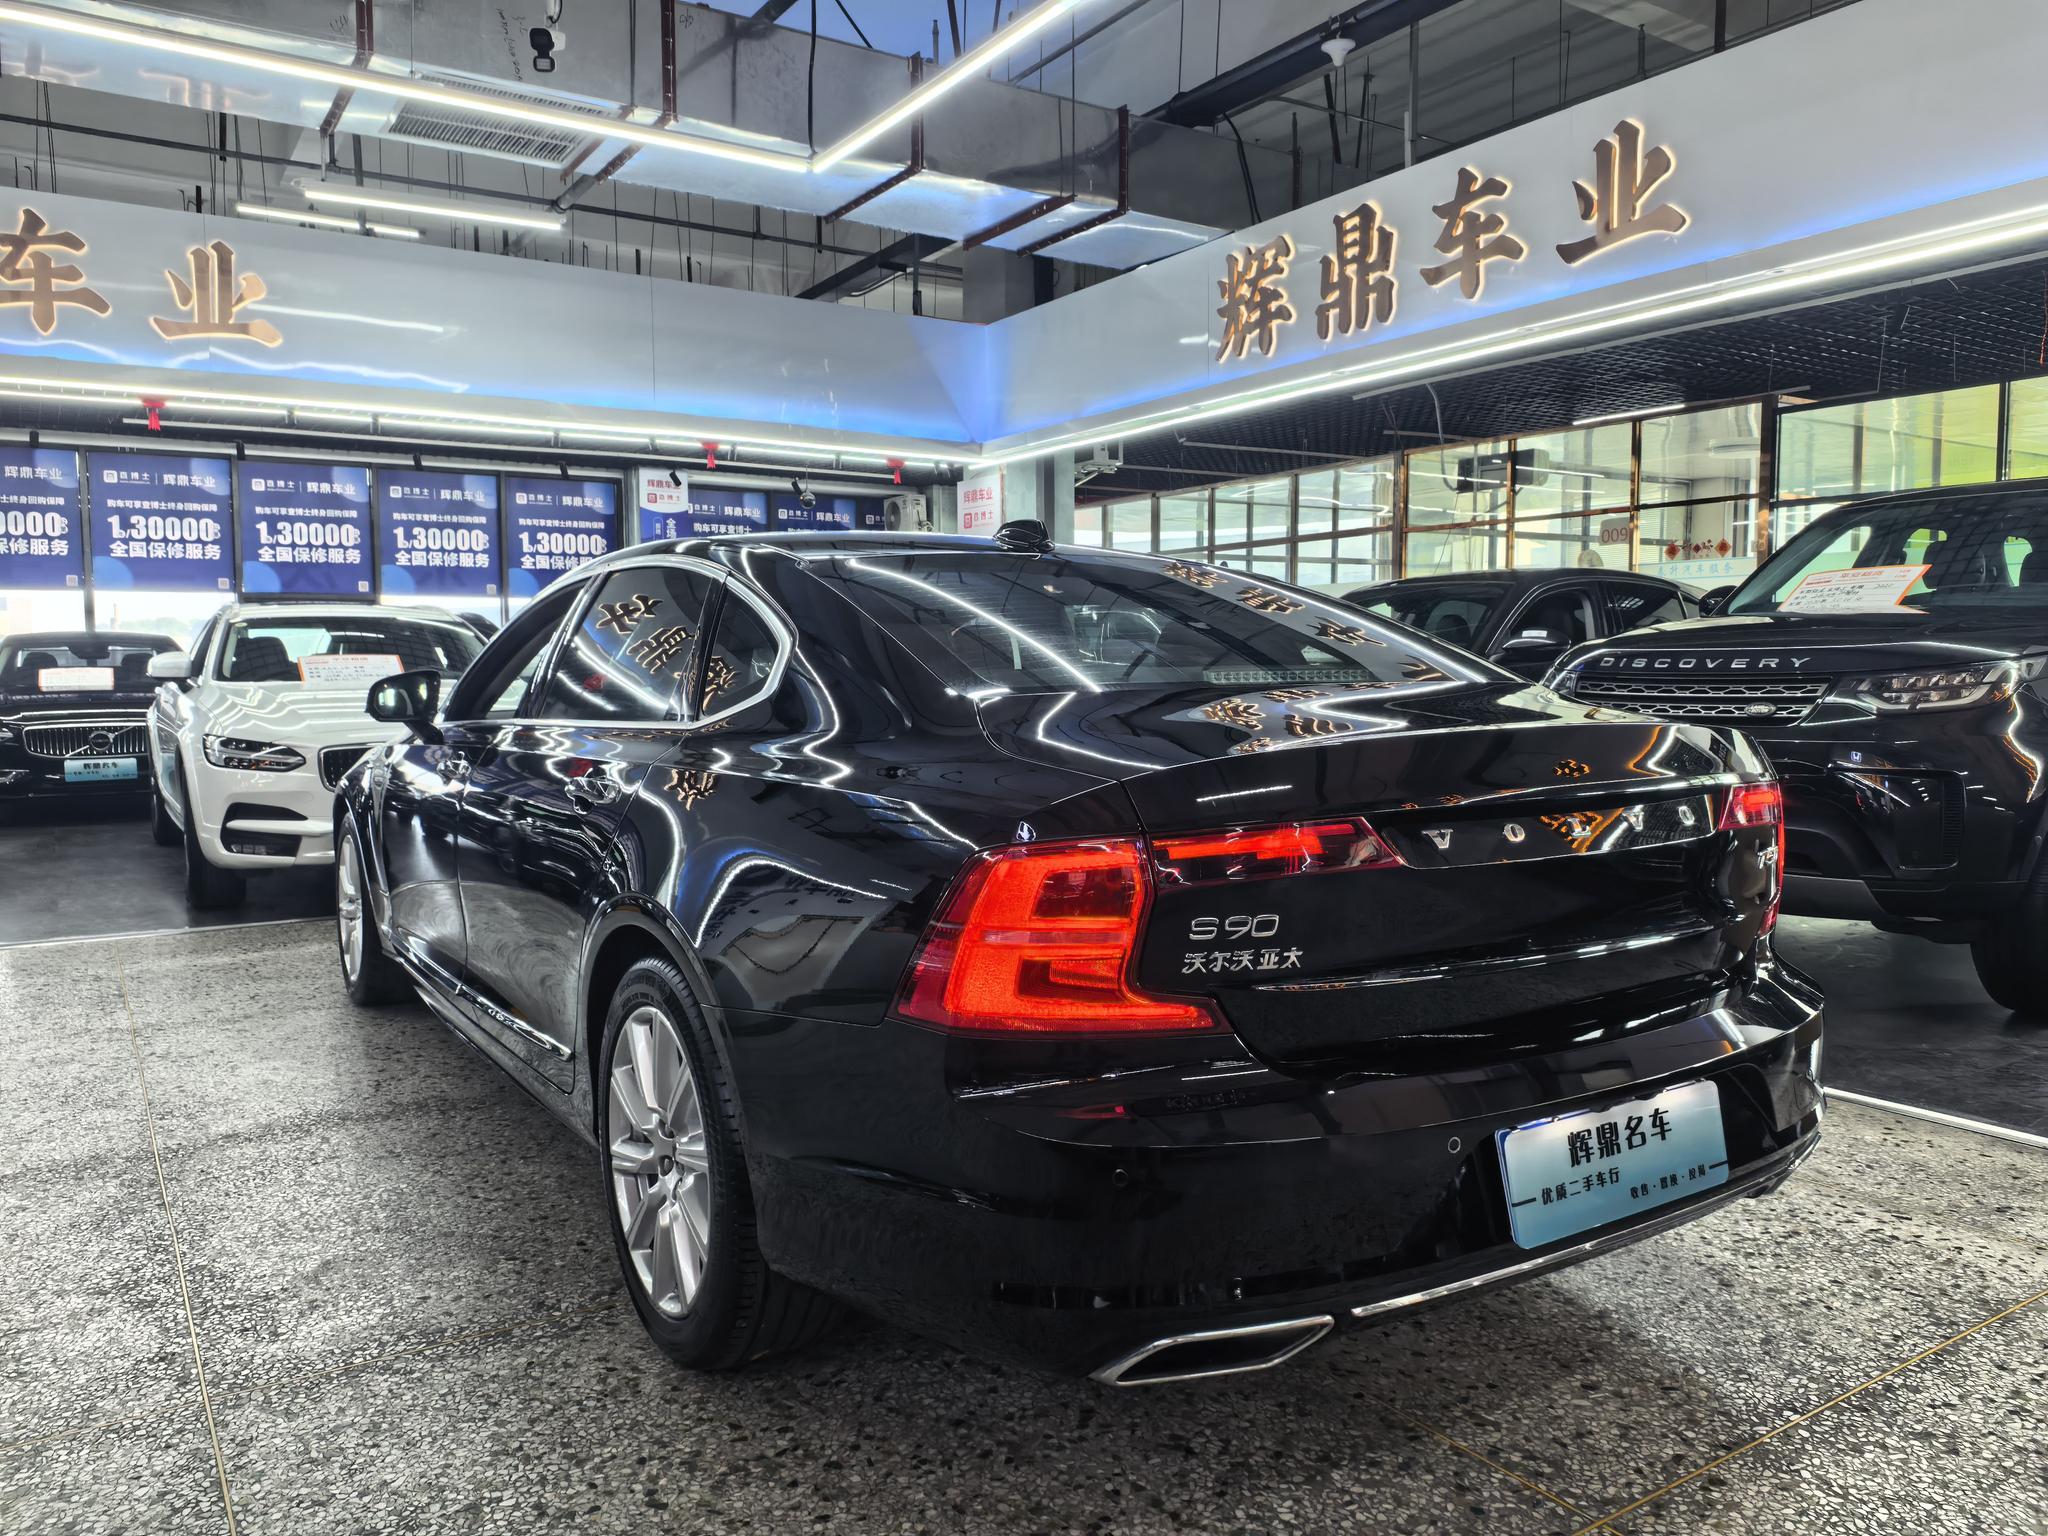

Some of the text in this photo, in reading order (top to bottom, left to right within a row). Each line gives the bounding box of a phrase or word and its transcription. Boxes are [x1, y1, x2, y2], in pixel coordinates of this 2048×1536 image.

[1215, 118, 1692, 363] 辉鼎车业
[4, 466, 63, 479] 辉鼎车业
[163, 474, 216, 487] 辉鼎车业
[307, 482, 356, 495] 辉鼎车业
[109, 540, 222, 560] 全国保修服务
[257, 546, 361, 564] 全国保修服务
[395, 550, 489, 568] 全国保修服务
[1599, 657, 1811, 669] DISCOVERY
[1421, 804, 1696, 849] VOLVO
[1188, 914, 1280, 940] S90
[1181, 946, 1304, 974] 沃尔沃亚太
[1567, 1107, 1673, 1169] 辉鼎名车
[1541, 1166, 1620, 1206] 优质二手车行
